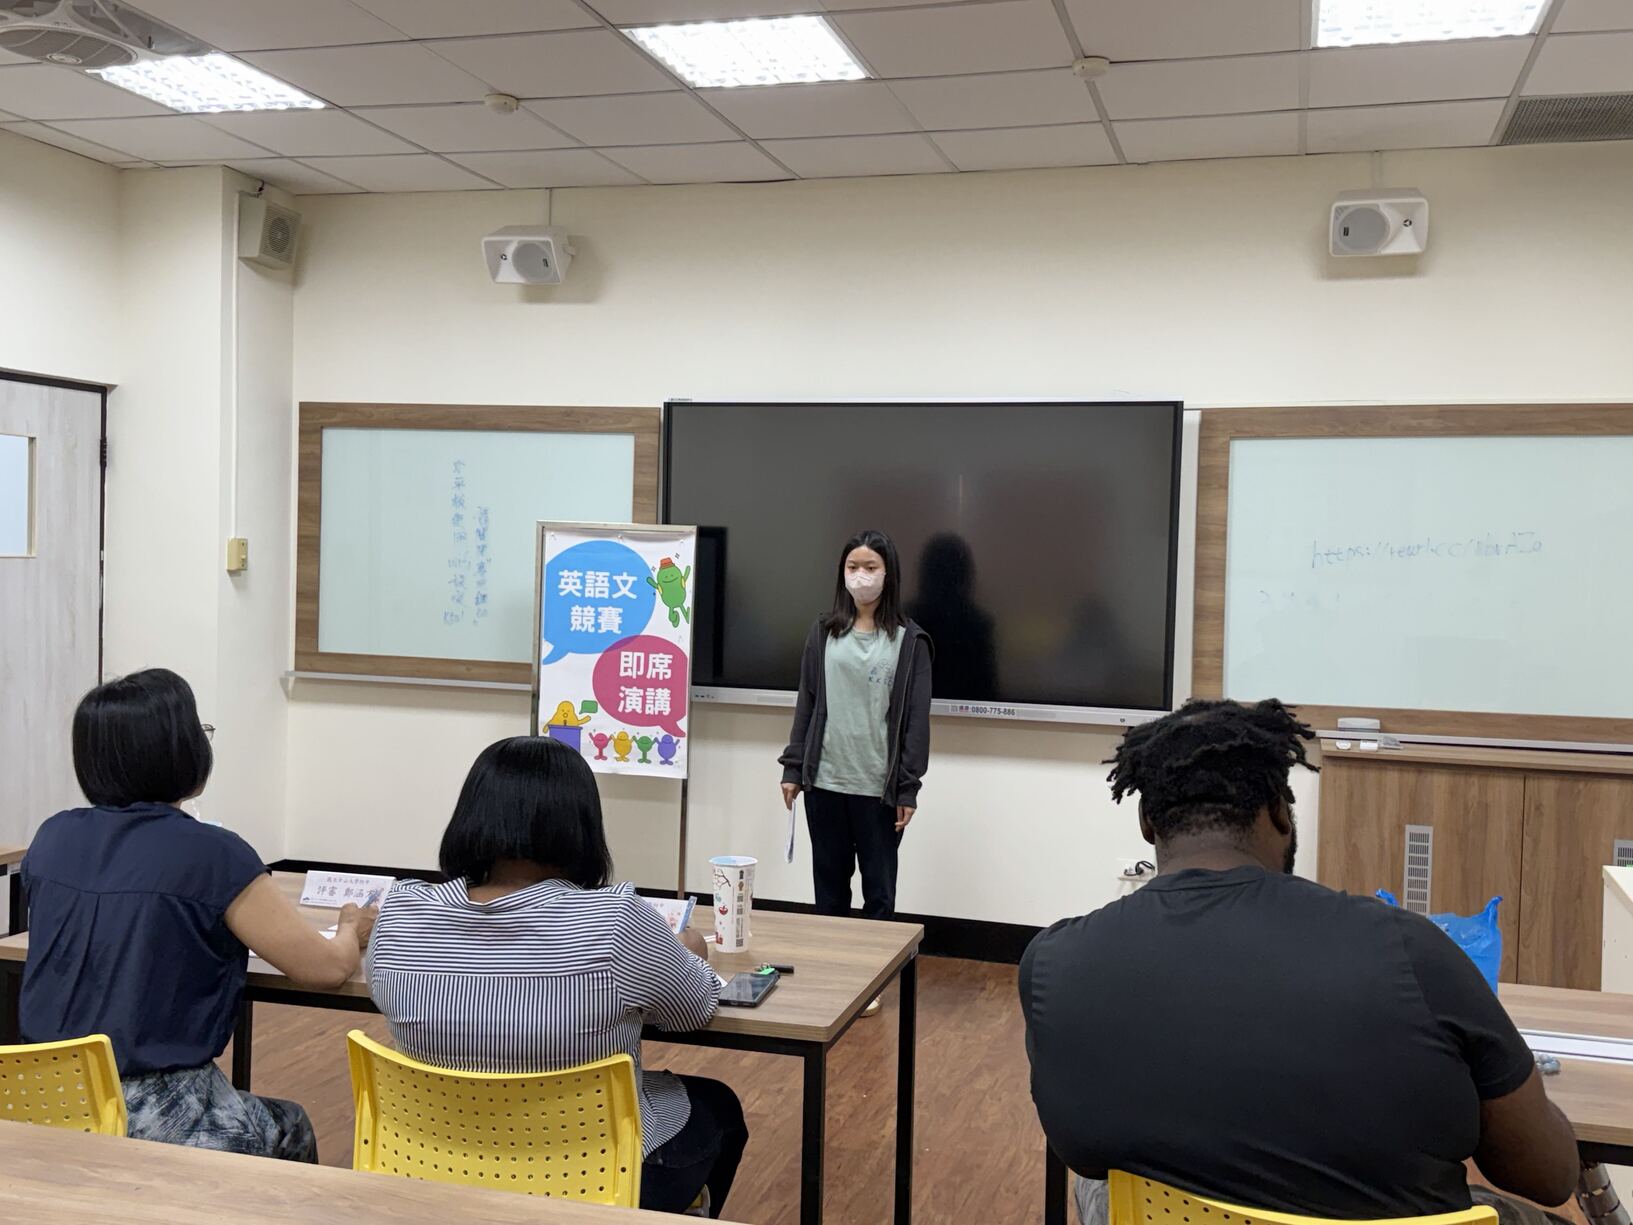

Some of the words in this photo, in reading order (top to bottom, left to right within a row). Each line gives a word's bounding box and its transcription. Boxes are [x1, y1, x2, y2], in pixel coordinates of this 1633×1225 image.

[558, 569, 638, 600] 英語文
[570, 605, 624, 634] 競賽
[618, 651, 673, 680] 即席
[617, 686, 671, 716] 演講
